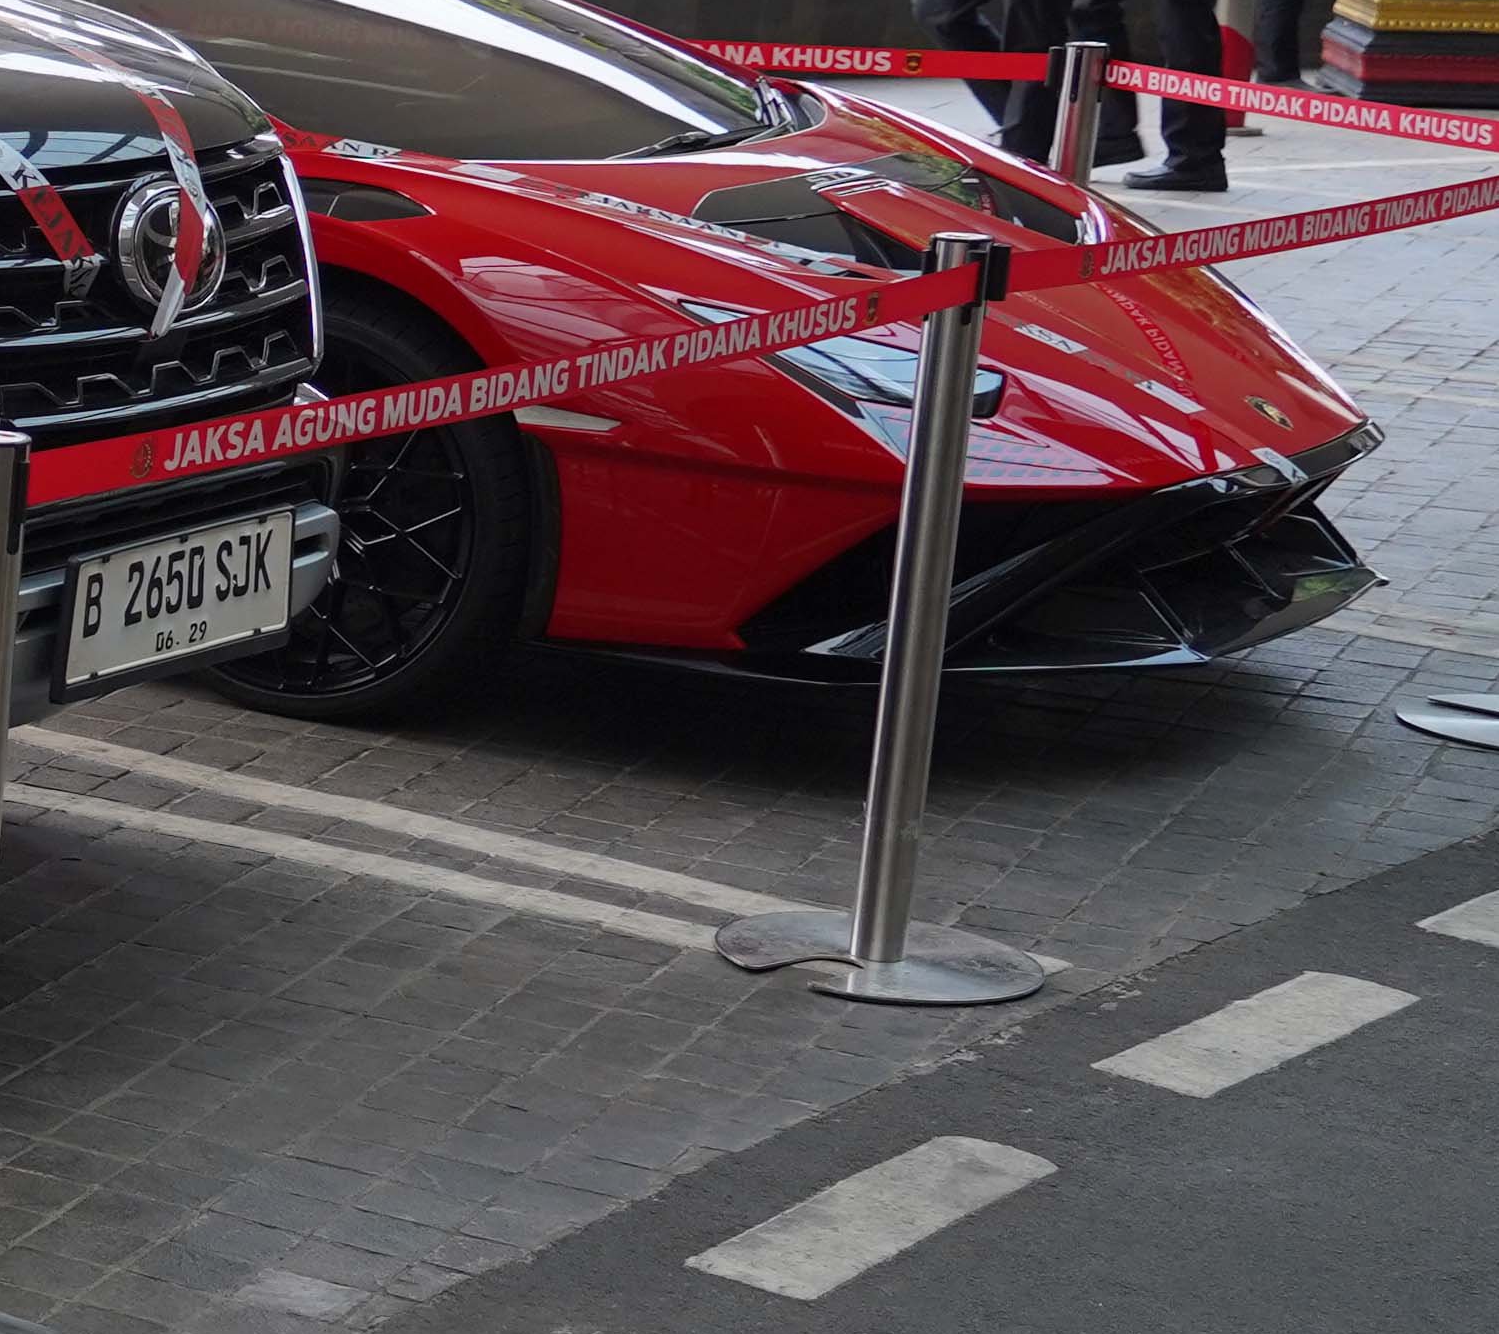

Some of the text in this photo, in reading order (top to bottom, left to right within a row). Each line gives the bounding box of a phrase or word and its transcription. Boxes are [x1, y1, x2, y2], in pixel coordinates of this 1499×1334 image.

[696, 43, 892, 72] ANA KHUSUS
[1104, 64, 1494, 146] UDA BIDANG TINDAK PIDANA KHUSUS
[1100, 175, 1499, 276] JAKSA AGUNG MUDA BIDANG TINDAK PIDANA
[163, 297, 858, 472] JAKSA AGUNG MUDA BIDANG TINDAK PIDANA KHUSUS
[82, 528, 274, 639] B 2650 SJK
